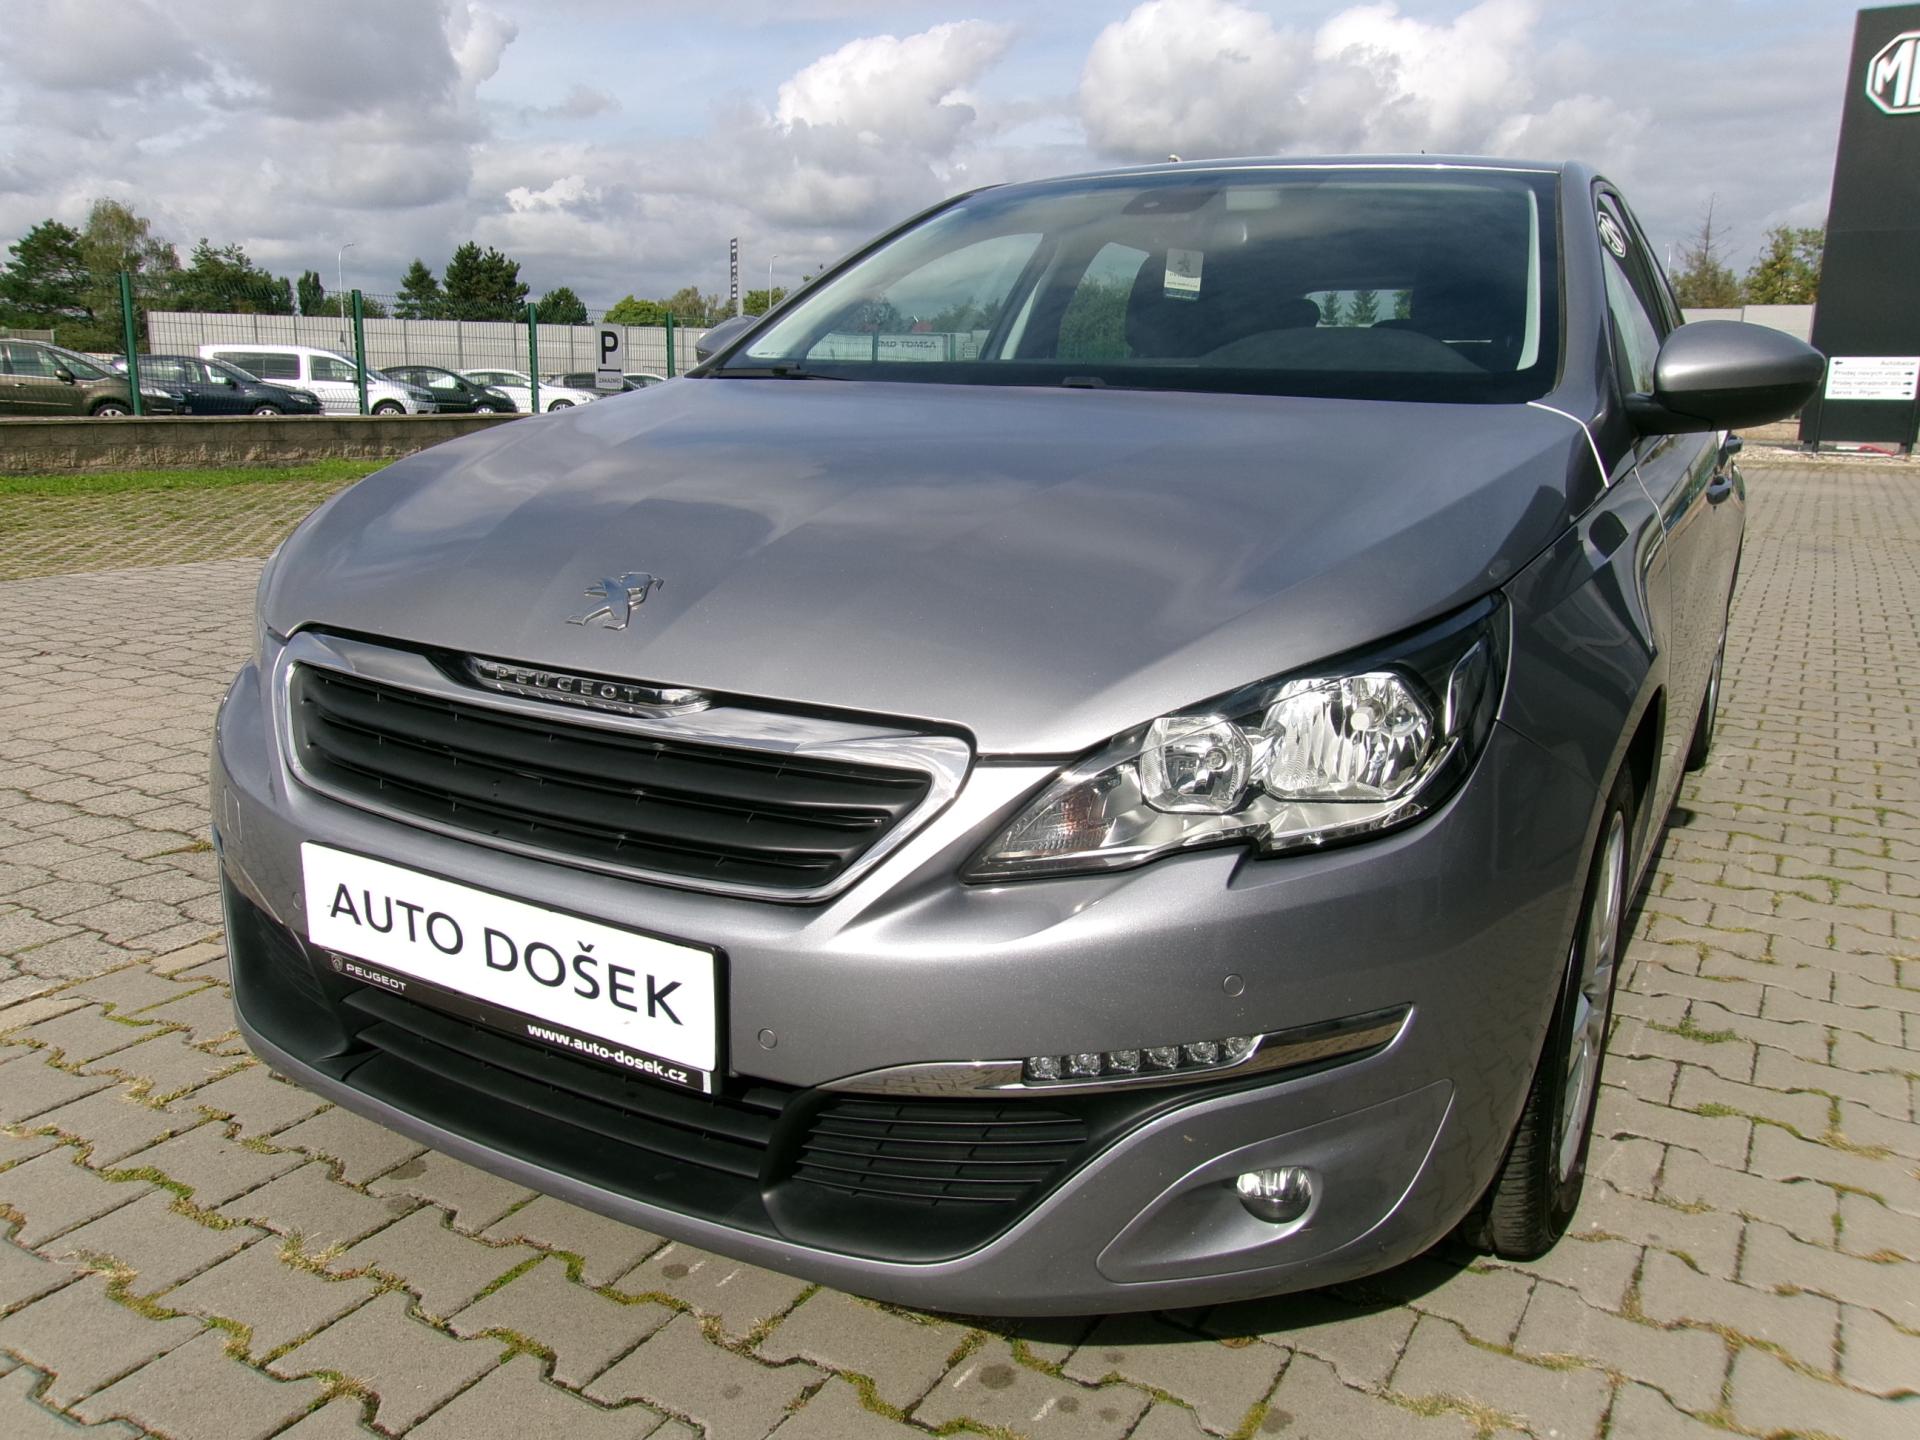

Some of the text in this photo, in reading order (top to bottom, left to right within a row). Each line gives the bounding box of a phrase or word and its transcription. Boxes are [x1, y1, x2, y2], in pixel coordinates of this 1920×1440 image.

[601, 331, 618, 364] P
[496, 666, 640, 702] PEUGEOT
[329, 883, 684, 1026] AUTO DOŠEK
[346, 963, 407, 991] PEUGEOT
[527, 1024, 688, 1083] www.auto-dosek.cz
